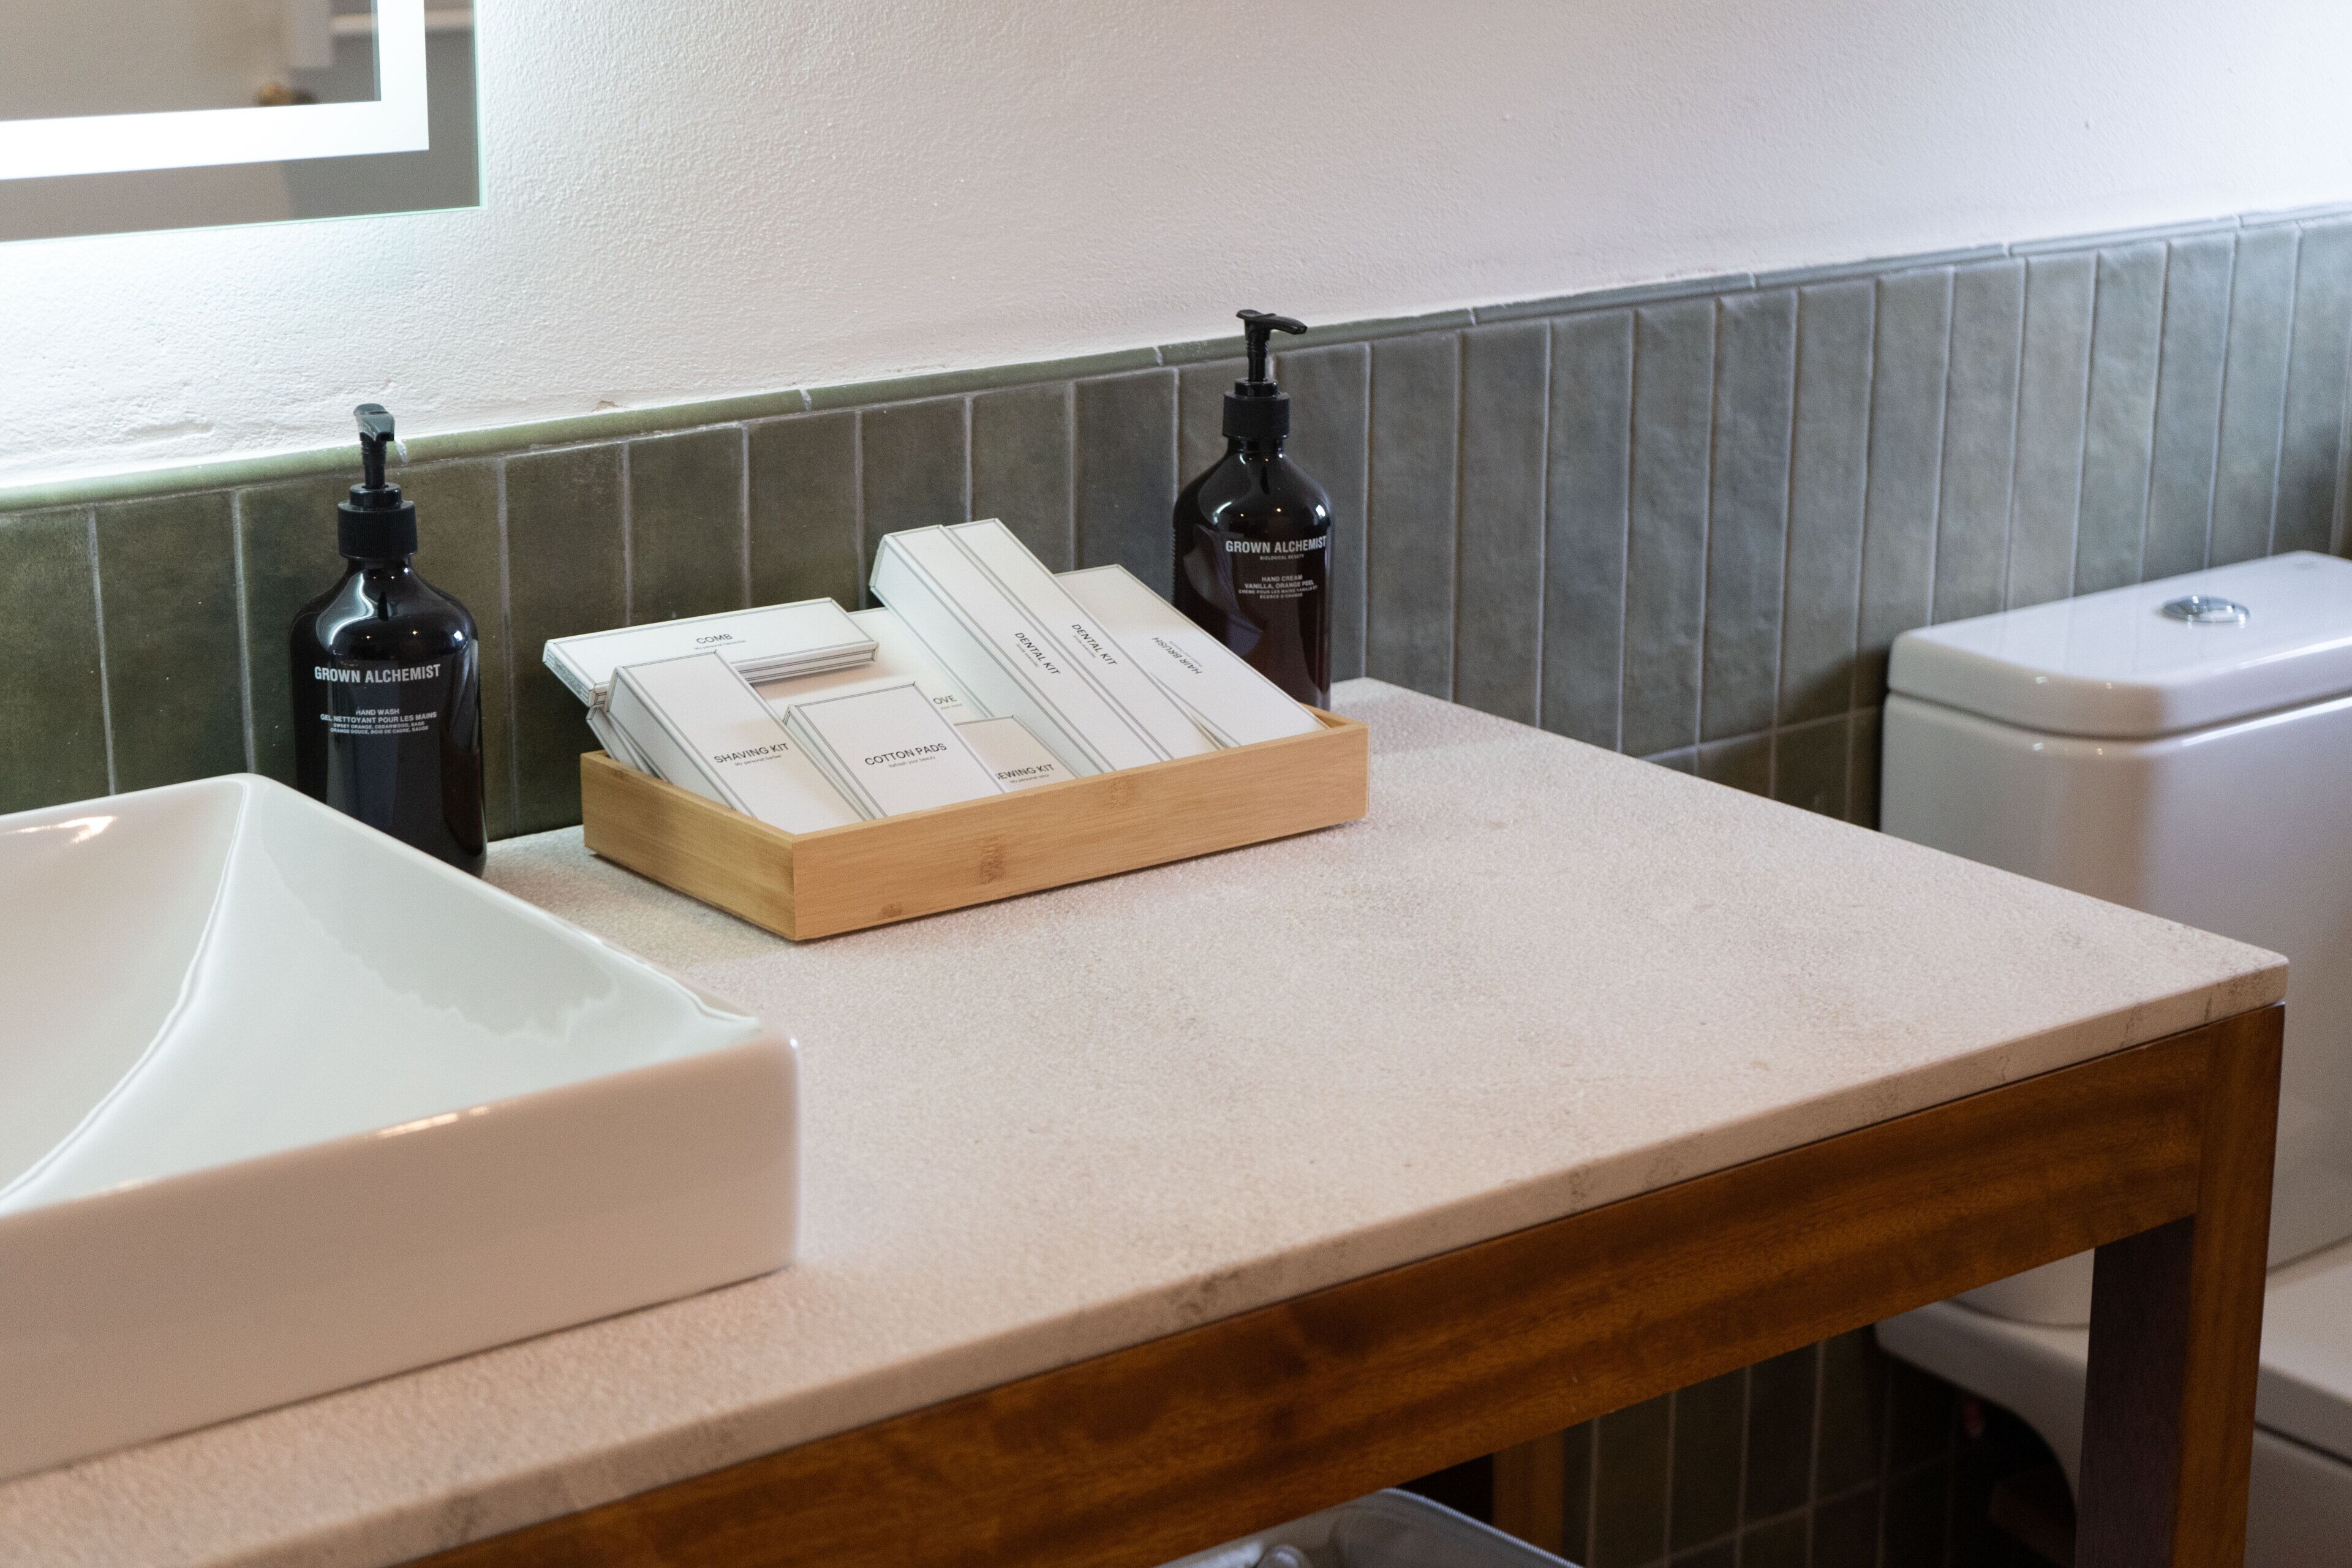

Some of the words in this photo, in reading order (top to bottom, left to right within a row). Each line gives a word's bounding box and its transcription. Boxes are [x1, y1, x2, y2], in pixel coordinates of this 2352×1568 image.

[1226, 540, 1270, 553] GROWN
[1275, 535, 1327, 552] ALCHEMIST
[696, 634, 733, 644] COMB
[1072, 624, 1102, 653] DENTAL
[1100, 654, 1117, 665] KIT
[1152, 637, 1182, 658] BRUSH
[1015, 633, 1046, 662] DENTAL
[1043, 662, 1061, 674] KIT
[314, 666, 361, 683] GROWN
[365, 664, 441, 683] ALCHEMIST
[1179, 658, 1202, 674] HAIR
[933, 695, 957, 704] OVE
[415, 711, 437, 720] MAINS
[714, 747, 769, 763] SHAVING
[769, 743, 789, 752] KIT
[865, 748, 915, 766] COTTON
[915, 743, 947, 755] PADS
[1036, 764, 1054, 772] KIT
